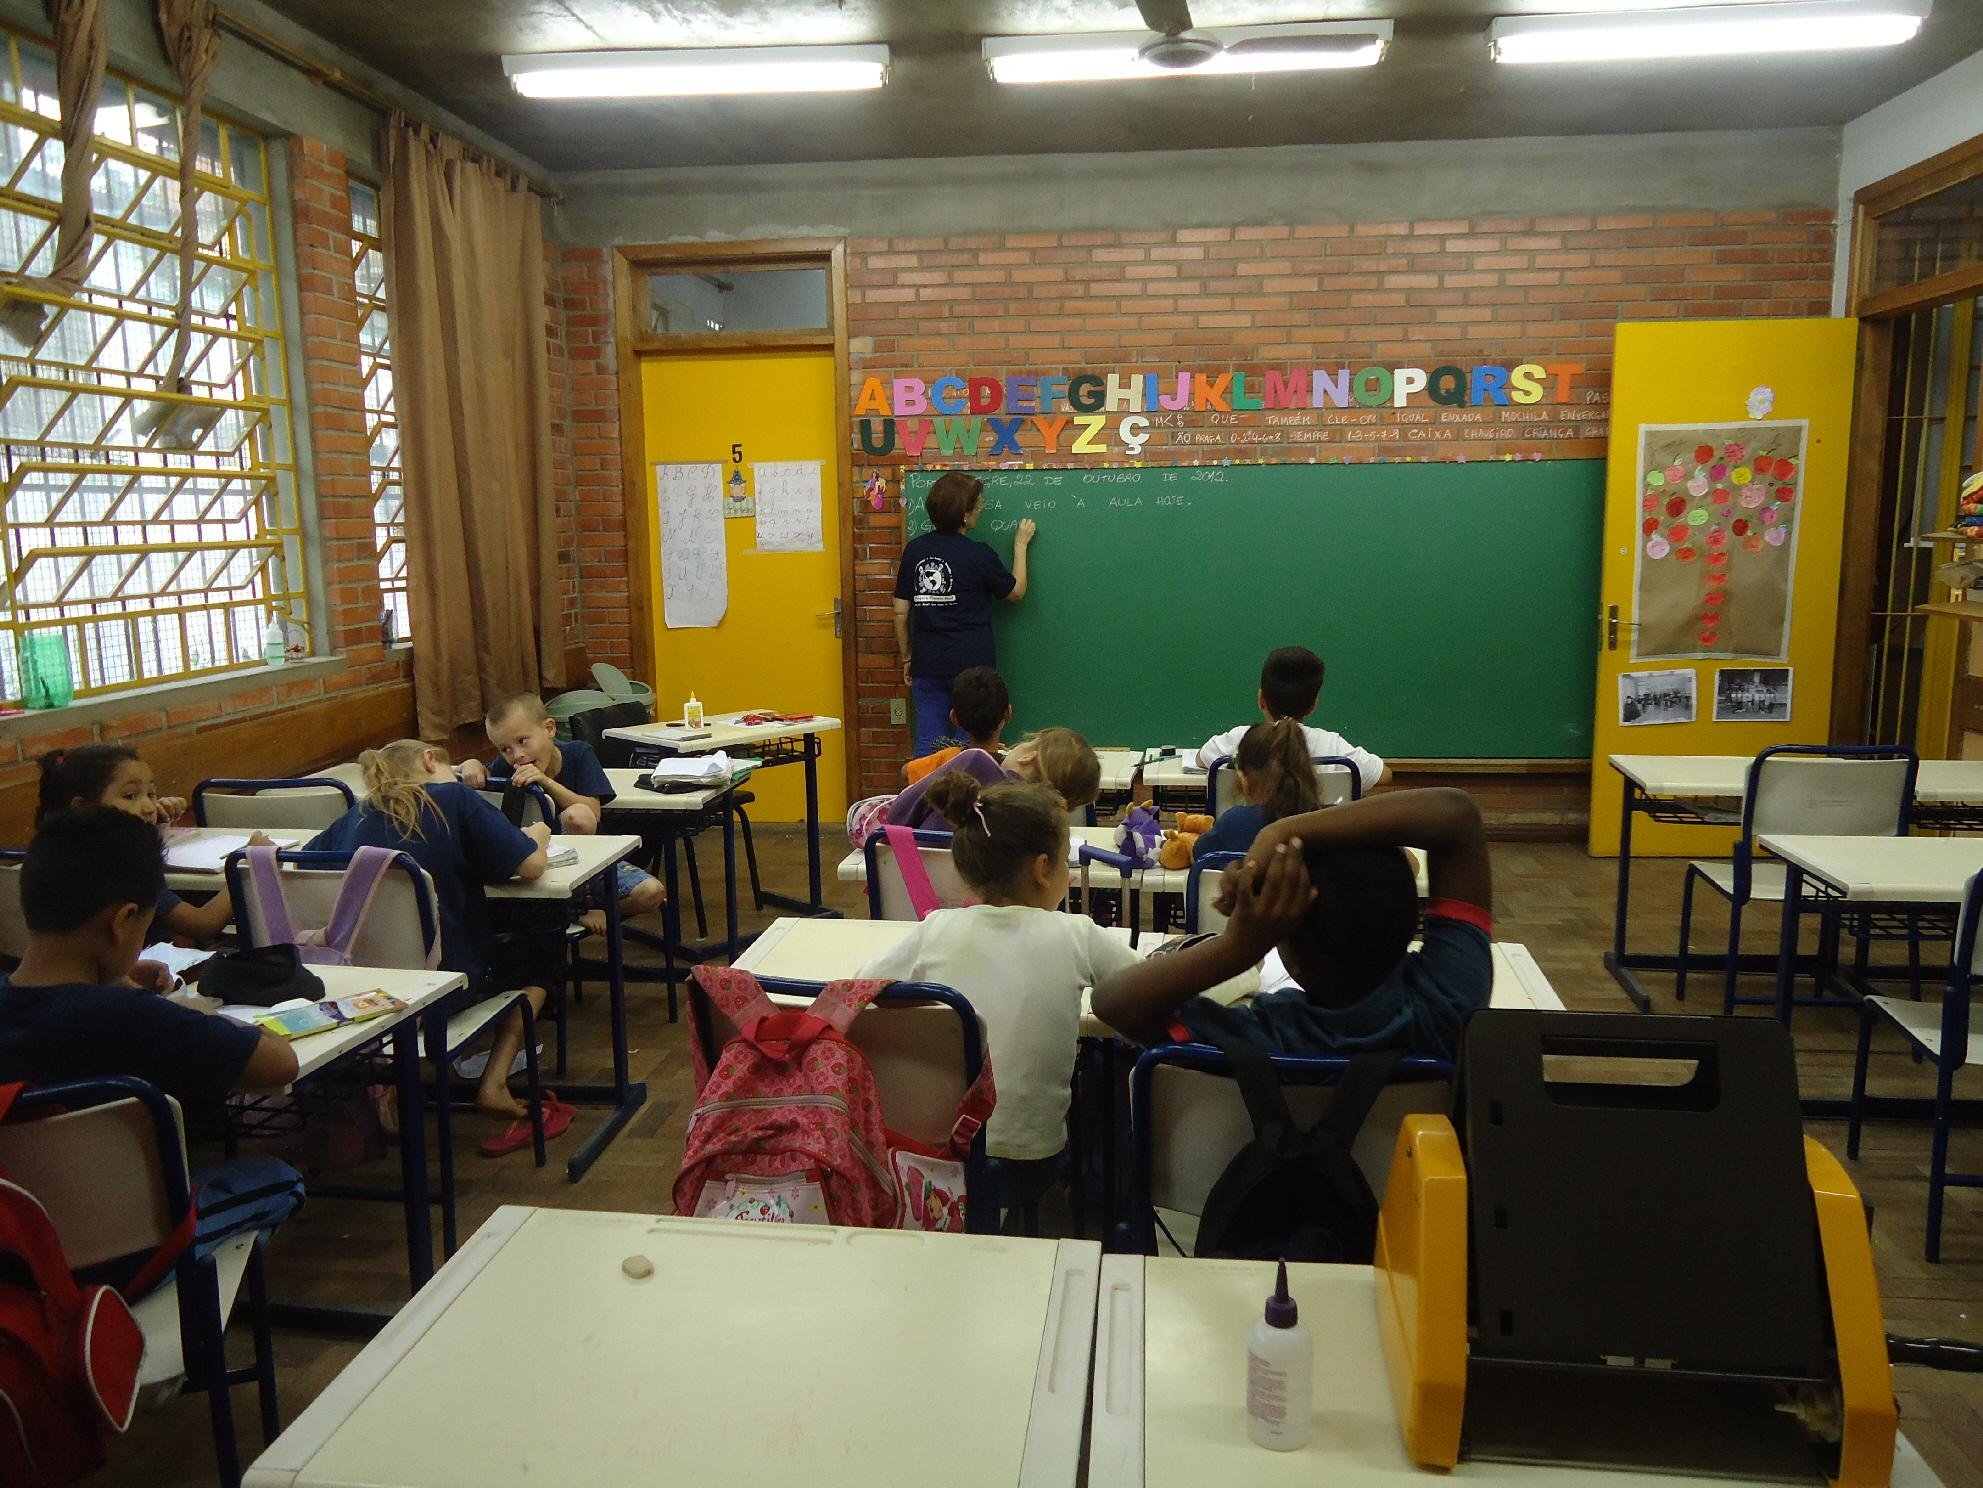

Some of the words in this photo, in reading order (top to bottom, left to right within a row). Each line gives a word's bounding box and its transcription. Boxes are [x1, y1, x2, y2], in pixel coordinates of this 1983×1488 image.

[1265, 412, 1311, 426] TAMBÉM
[1441, 412, 1482, 423] ENXADA
[1501, 408, 1550, 422] MOCHILA
[1290, 430, 1329, 441] SEMPRE
[731, 444, 743, 464] 5
[1044, 476, 1063, 486] DE
[1082, 473, 1141, 484] OUTUBRO
[1162, 472, 1178, 482] DE
[1191, 470, 1229, 484] 2012.
[1025, 499, 1056, 510] VEIO
[1109, 496, 1143, 507] AULA
